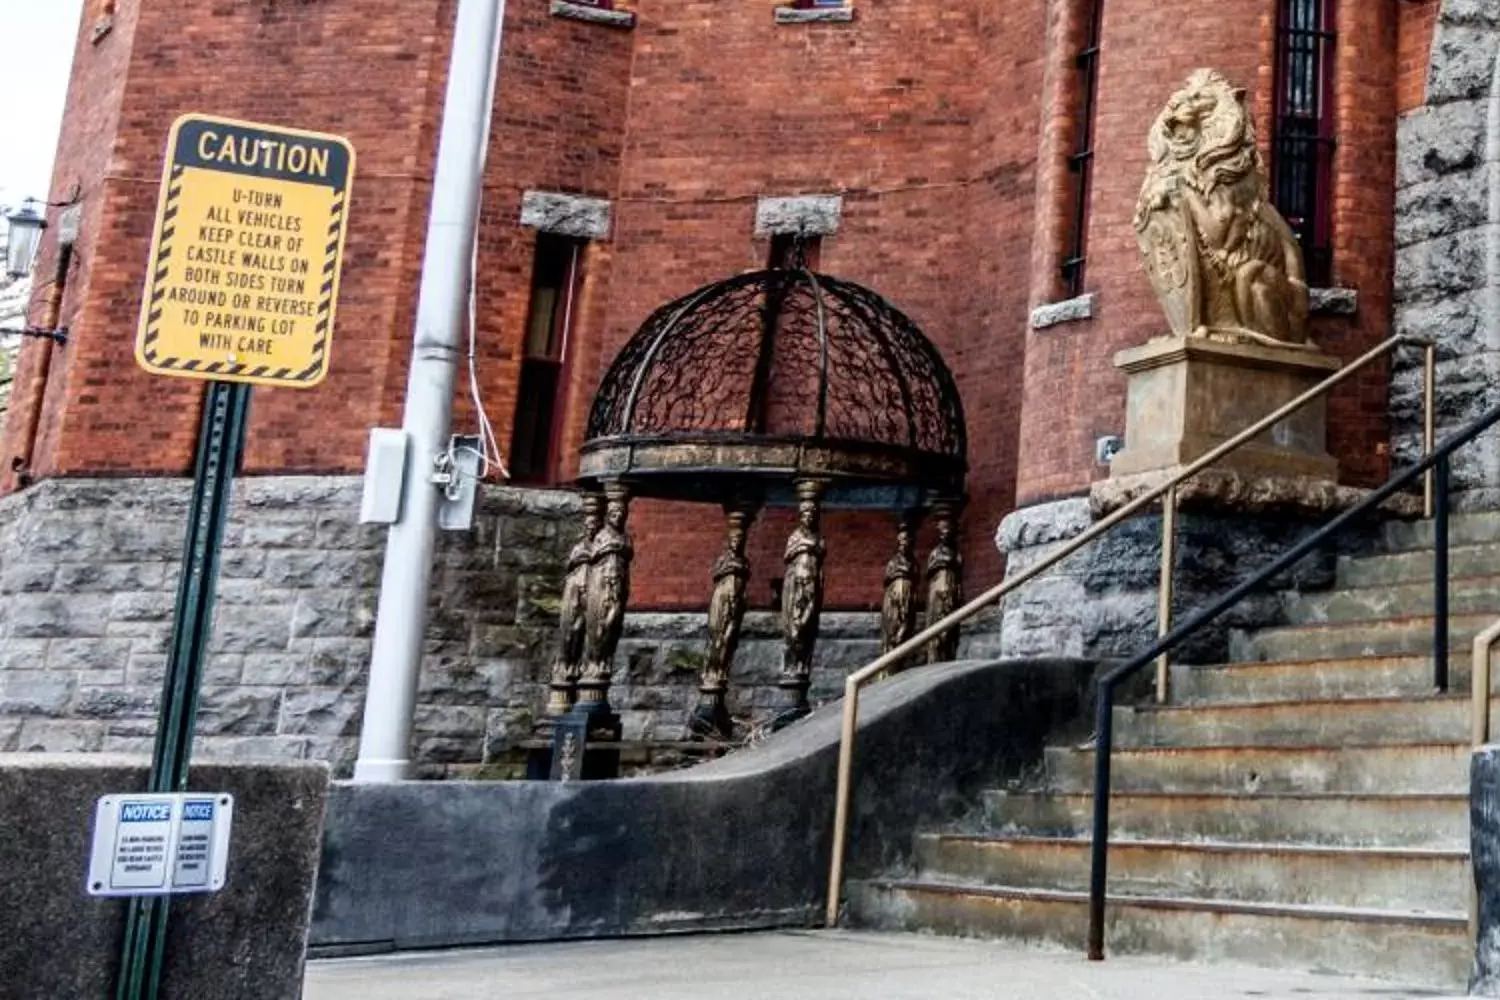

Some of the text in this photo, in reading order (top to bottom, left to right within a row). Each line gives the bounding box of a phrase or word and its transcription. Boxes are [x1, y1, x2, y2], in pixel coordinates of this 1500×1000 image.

[198, 131, 329, 177] CAUTION
[232, 188, 282, 208] U-TURN
[206, 205, 302, 232] ALL VEHICLES
[199, 226, 304, 252] KEEP CLEAR OF
[187, 245, 308, 274] CASTLE WALLS ON
[184, 266, 305, 294] BOTH SIDES TURN
[168, 286, 314, 316] AROUND OR REVERSE
[184, 309, 296, 336] TO PARKING LOT
[200, 332, 272, 354] WITH CARE
[123, 804, 169, 819] NOTICE
[184, 803, 211, 818] NOTICE
